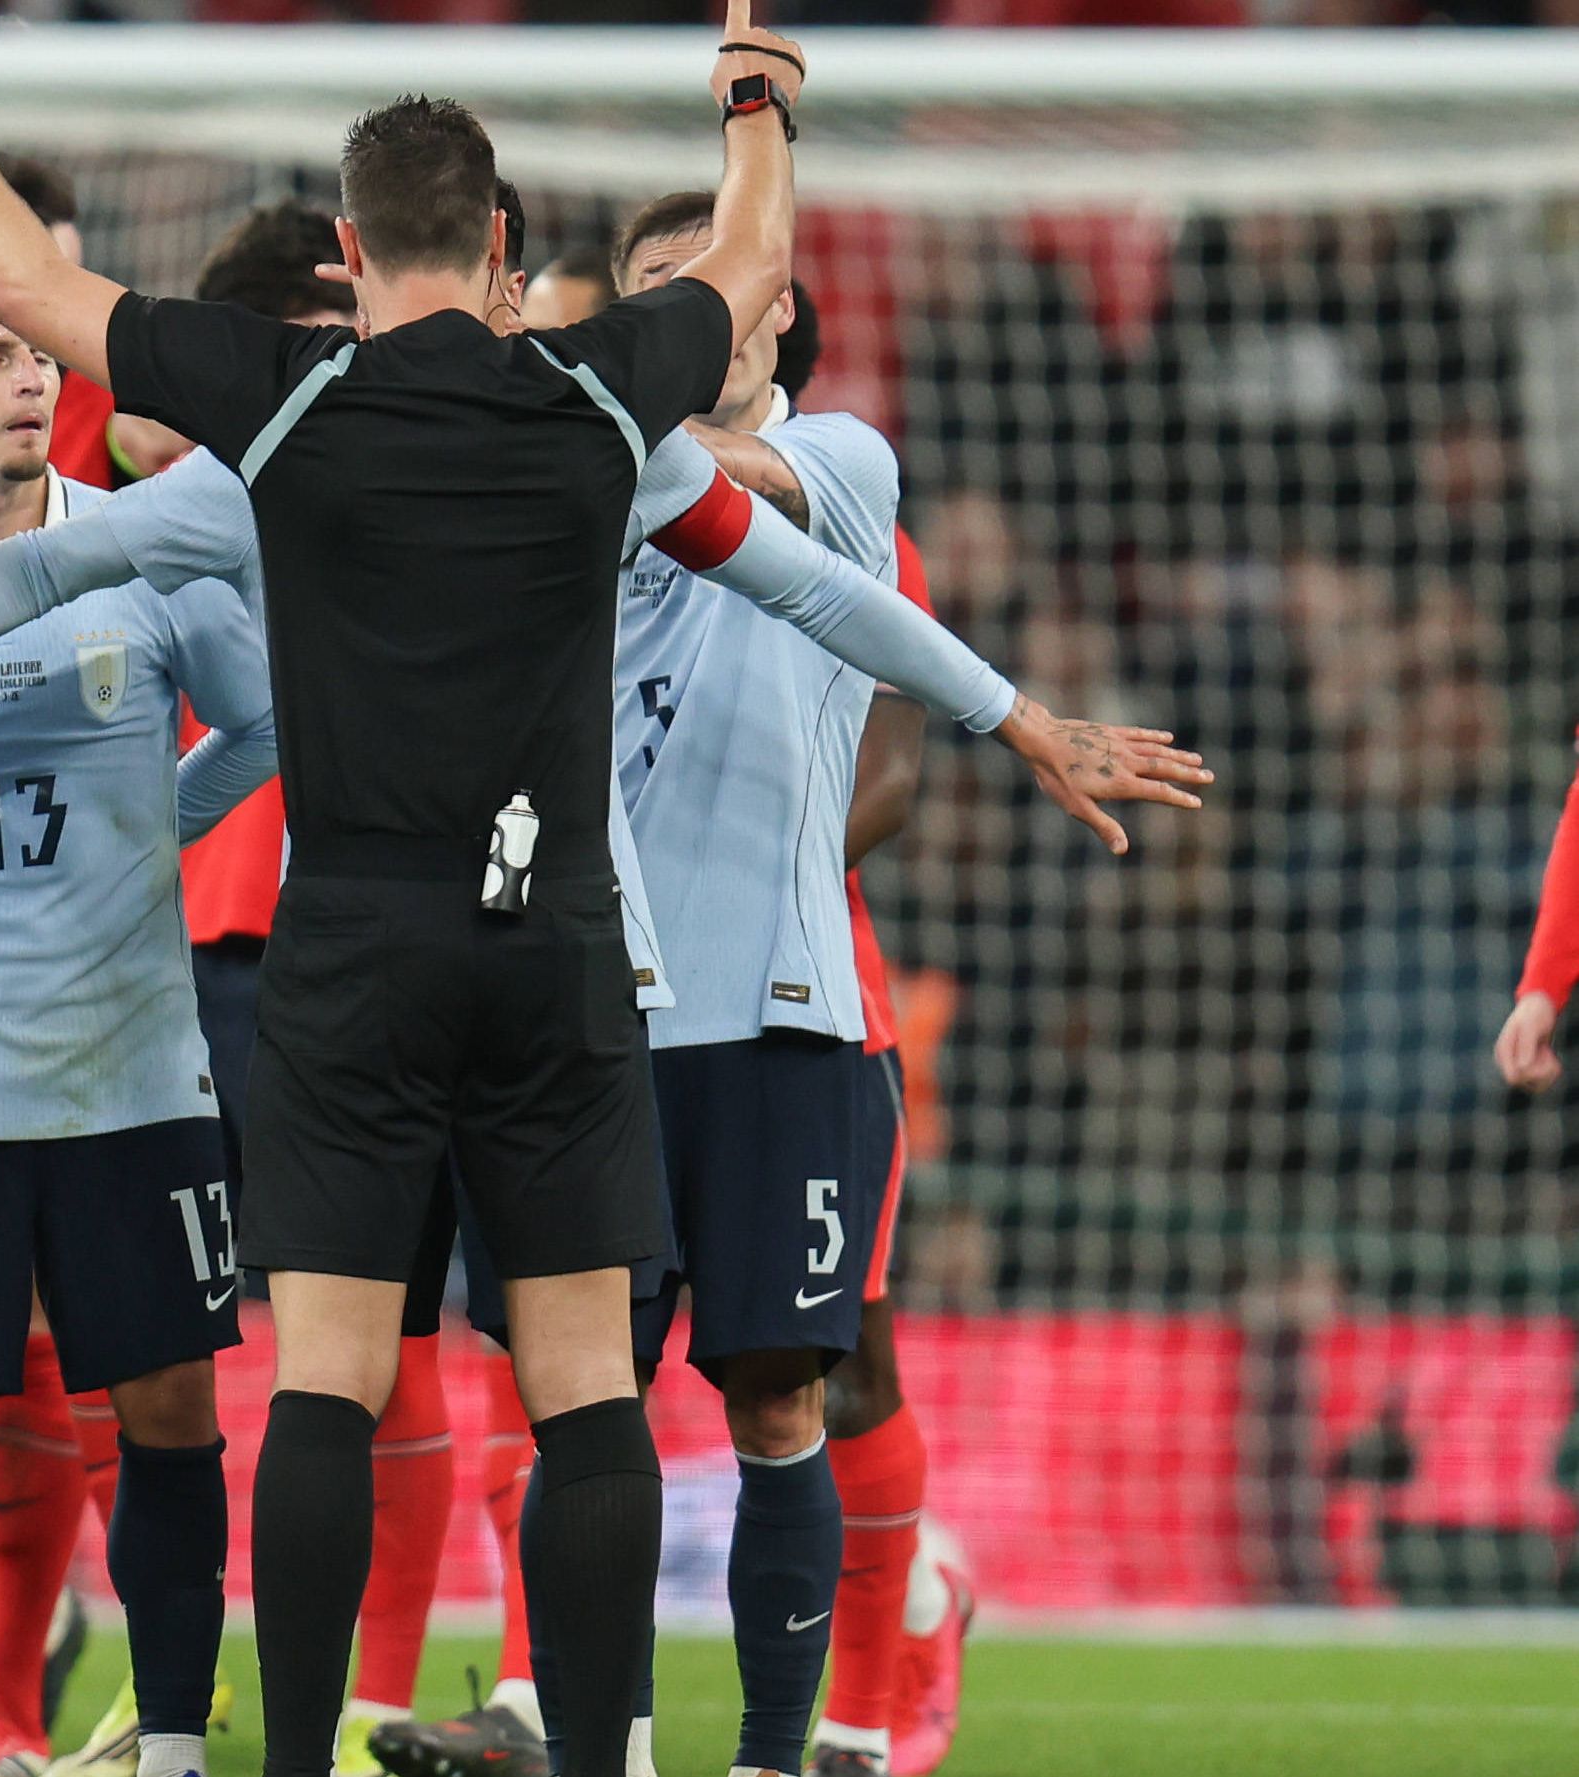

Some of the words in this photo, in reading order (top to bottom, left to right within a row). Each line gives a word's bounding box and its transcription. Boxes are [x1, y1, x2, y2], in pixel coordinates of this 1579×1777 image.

[638, 674, 676, 769] 5
[169, 1180, 235, 1282] 13
[806, 1179, 845, 1274] 5
